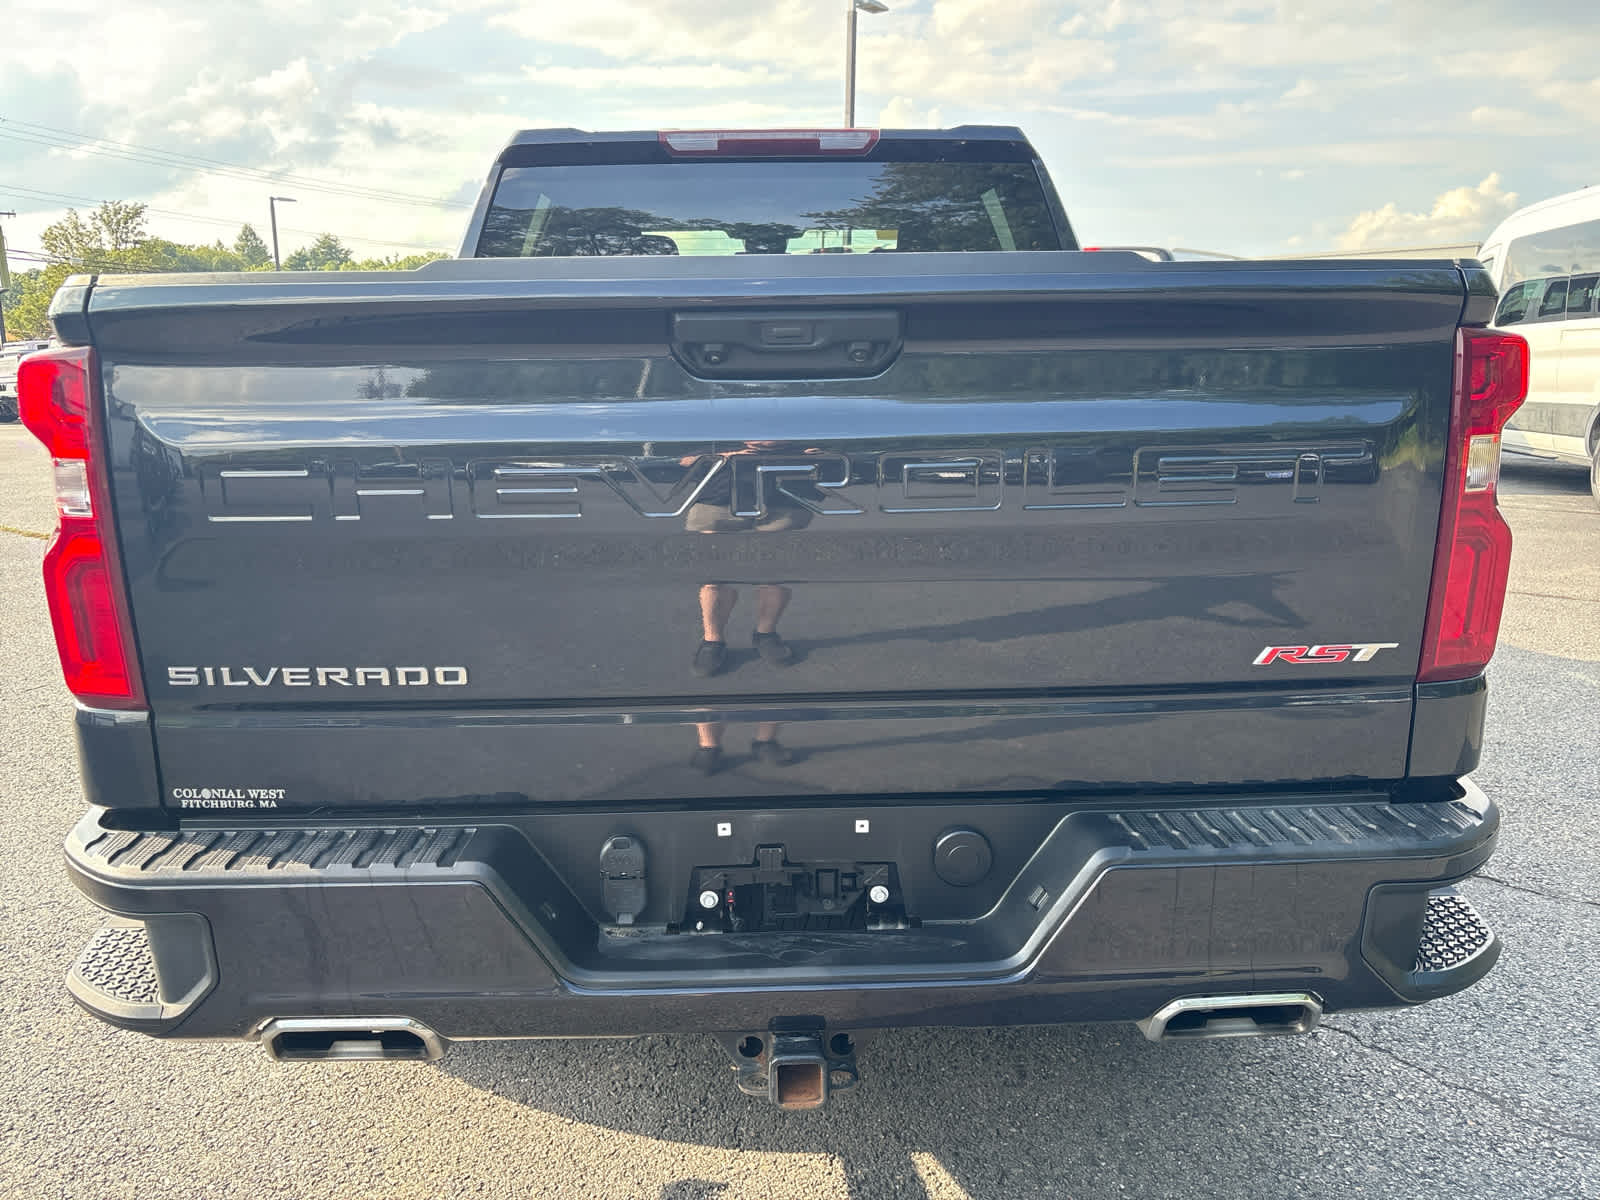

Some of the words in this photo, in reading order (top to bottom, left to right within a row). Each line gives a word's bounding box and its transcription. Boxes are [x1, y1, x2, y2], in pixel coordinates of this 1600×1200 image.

[203, 441, 1377, 521] CHEVROLET
[1252, 642, 1399, 665] RST
[167, 666, 468, 686] SILVERADO
[173, 788, 245, 799] COLONIAL
[247, 789, 285, 799] WEST
[259, 799, 278, 808] MA
